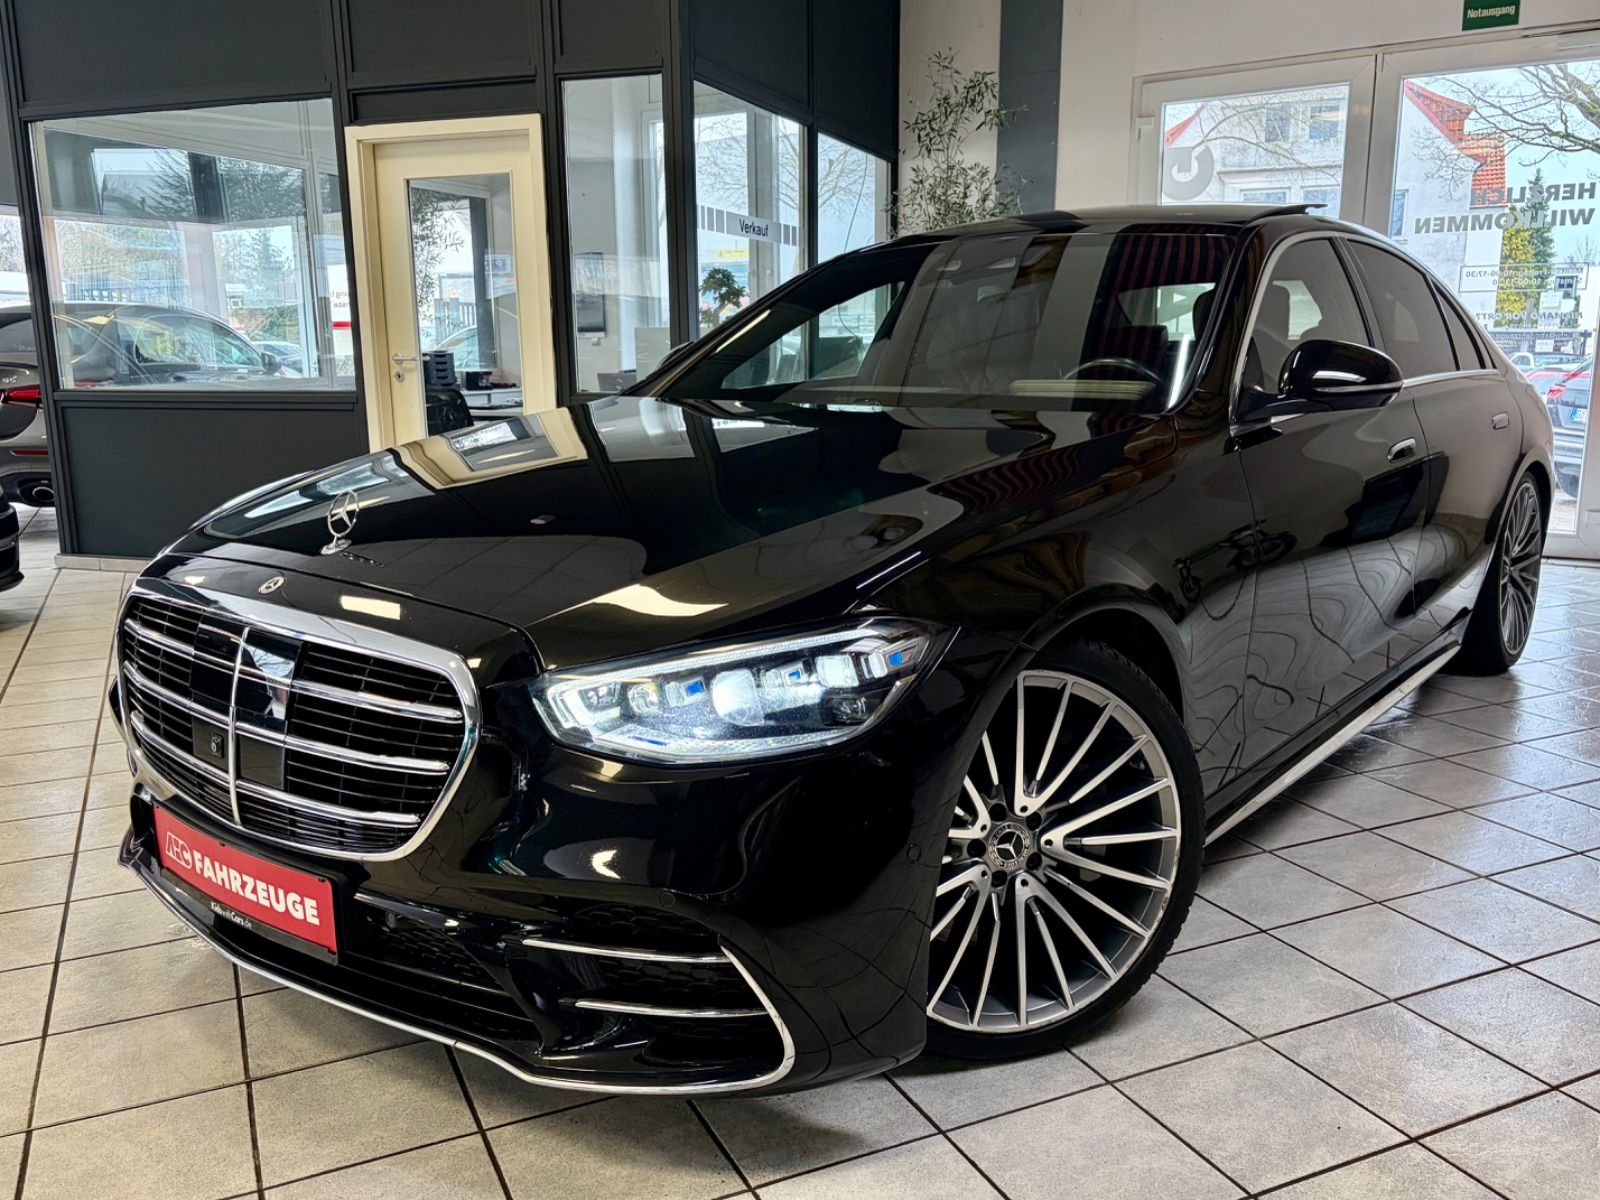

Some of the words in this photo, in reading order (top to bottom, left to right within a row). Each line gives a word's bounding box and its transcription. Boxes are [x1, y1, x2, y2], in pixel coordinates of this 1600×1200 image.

[1467, 5, 1516, 19] Notausgang
[739, 218, 769, 237] Verkauf
[193, 850, 321, 926] FAHRZEUGE
